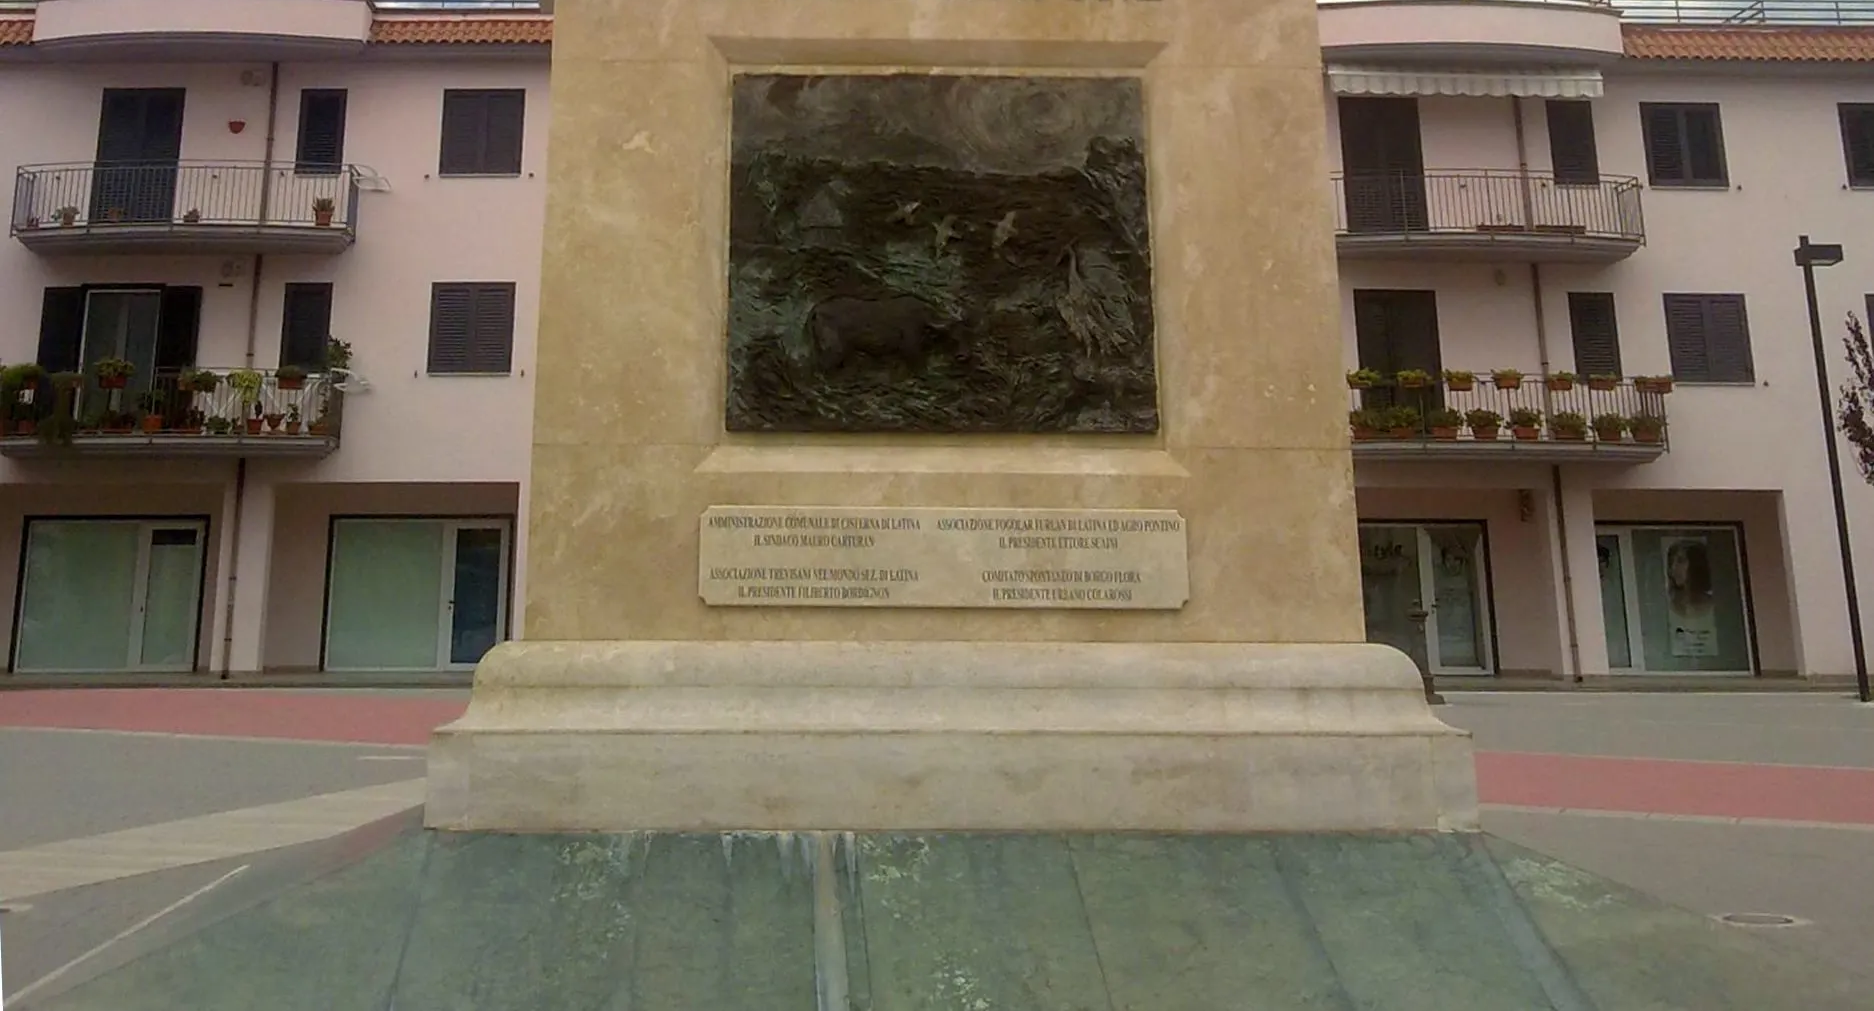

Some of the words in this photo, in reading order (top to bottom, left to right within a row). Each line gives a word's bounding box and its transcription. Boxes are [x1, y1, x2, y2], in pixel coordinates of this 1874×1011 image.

[784, 516, 829, 530] COMUNALE
[831, 517, 839, 530] DI
[841, 517, 880, 530] CISTERNA
[881, 517, 889, 530] DI
[891, 517, 921, 530] LATINA
[936, 518, 994, 531] ASSOCIAZIONE
[1078, 519, 1106, 532] LATINA
[1144, 520, 1180, 532] PONTINO
[753, 534, 760, 546] IL
[763, 534, 799, 547] SINDACO
[999, 536, 1006, 549] IL
[1008, 536, 1056, 549] PRESIDENTE
[1058, 537, 1088, 549] ETTORE
[709, 567, 767, 580] ASSOCIAZIONE
[889, 569, 919, 582] LATINA
[1114, 571, 1141, 583] FLORA
[738, 586, 745, 598] IL
[747, 586, 796, 599] PRESIDENTE
[992, 588, 1000, 600] IL
[1002, 588, 1050, 600] PRESIDENTE
